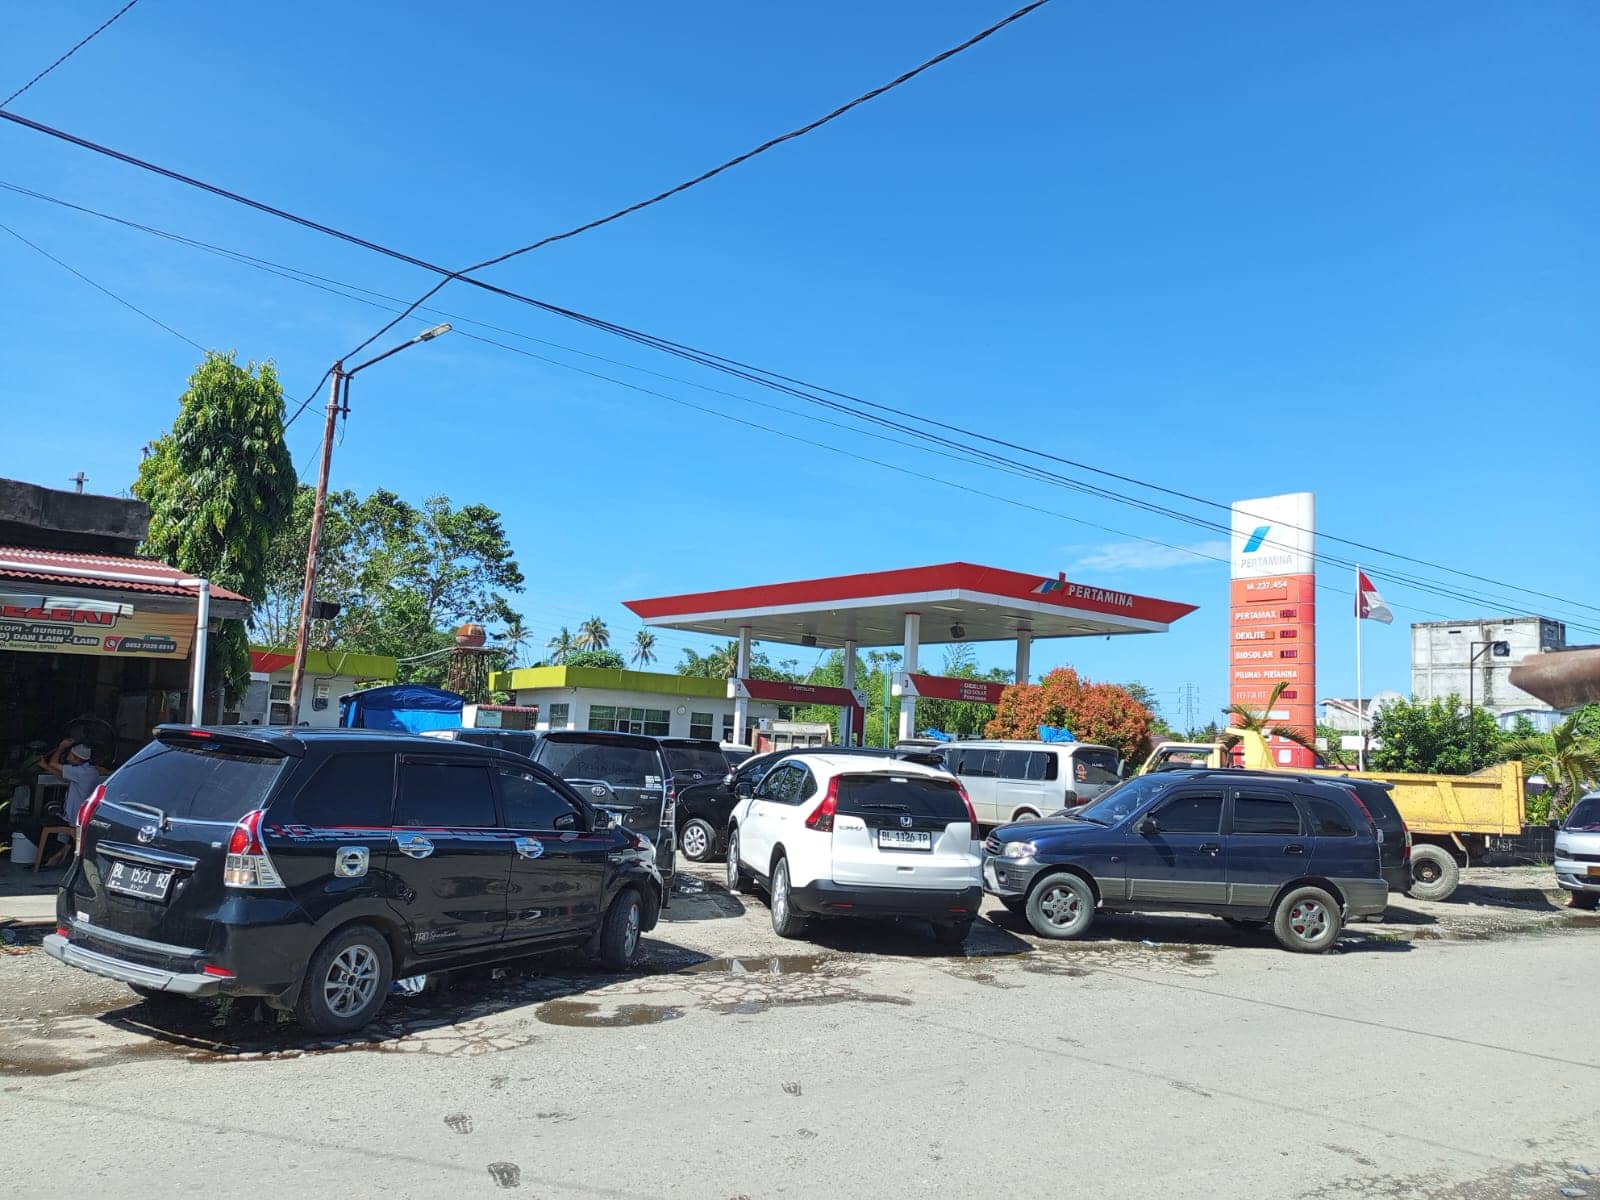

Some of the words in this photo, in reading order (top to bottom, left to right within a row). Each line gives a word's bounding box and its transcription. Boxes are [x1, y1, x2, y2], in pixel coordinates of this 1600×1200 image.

[1241, 555, 1293, 568] PERTAMINA
[1068, 584, 1134, 608] PERTAMINA
[0, 605, 114, 625] EZEKI
[1235, 610, 1277, 620] PERTAMAX
[32, 627, 71, 636] BUMBU
[1235, 631, 1266, 640] DEXLITE
[13, 632, 36, 641] DAN
[39, 634, 64, 643] LAIN
[73, 637, 98, 645] LAIN
[882, 831, 892, 841] BL
[896, 832, 915, 842] 1126
[918, 833, 928, 843] TP
[112, 862, 124, 879] BL
[130, 868, 152, 884] 1523
[155, 873, 170, 888] BZ
[414, 931, 429, 942] TRD
